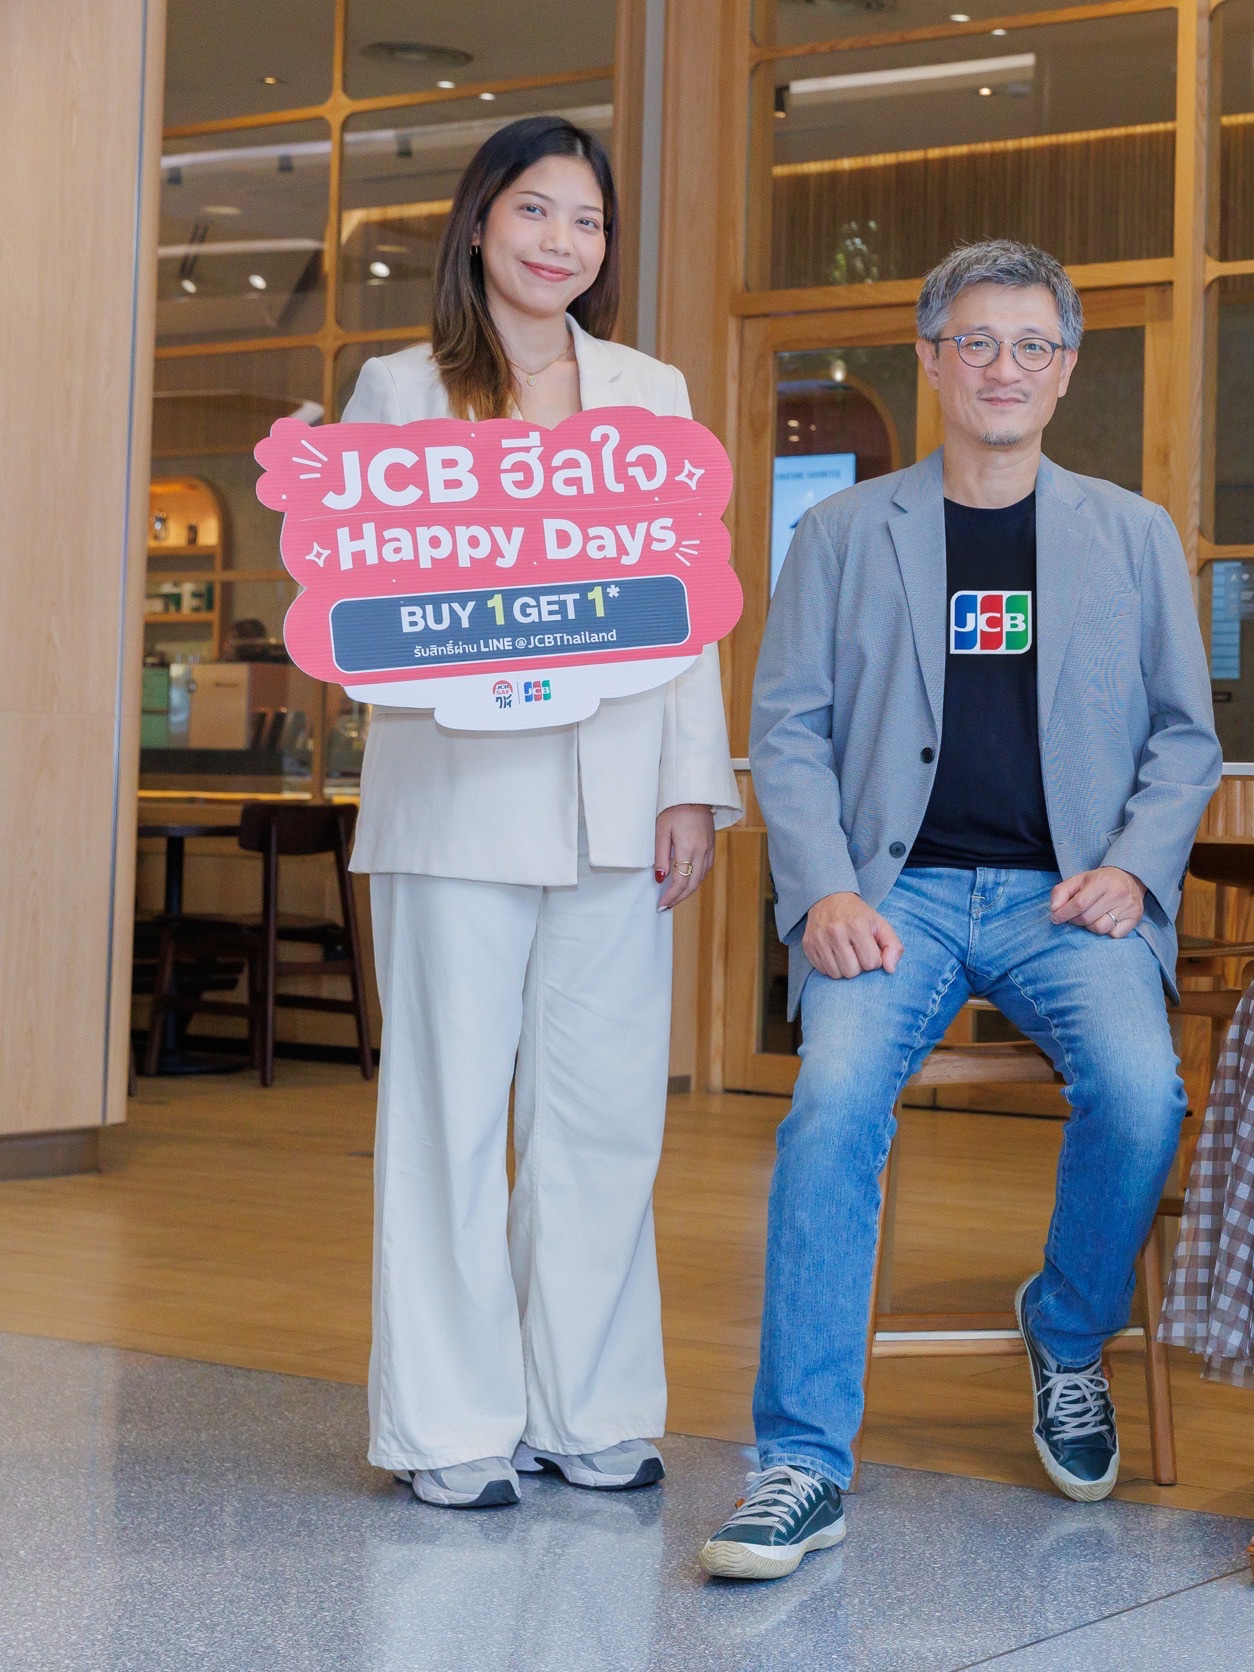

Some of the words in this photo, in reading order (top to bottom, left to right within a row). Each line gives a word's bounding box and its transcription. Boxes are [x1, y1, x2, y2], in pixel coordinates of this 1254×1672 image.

[322, 446, 479, 510] JCB
[500, 425, 668, 498] ฮีลใจ
[336, 522, 524, 571] Happy
[543, 518, 676, 565] Days
[400, 601, 476, 633] BUY
[487, 593, 505, 625] 1
[513, 593, 580, 624] GET
[414, 640, 478, 658] รับสิทธิ์ผ่าน
[480, 638, 513, 652] LINE
[515, 629, 617, 650] @JCBThailand
